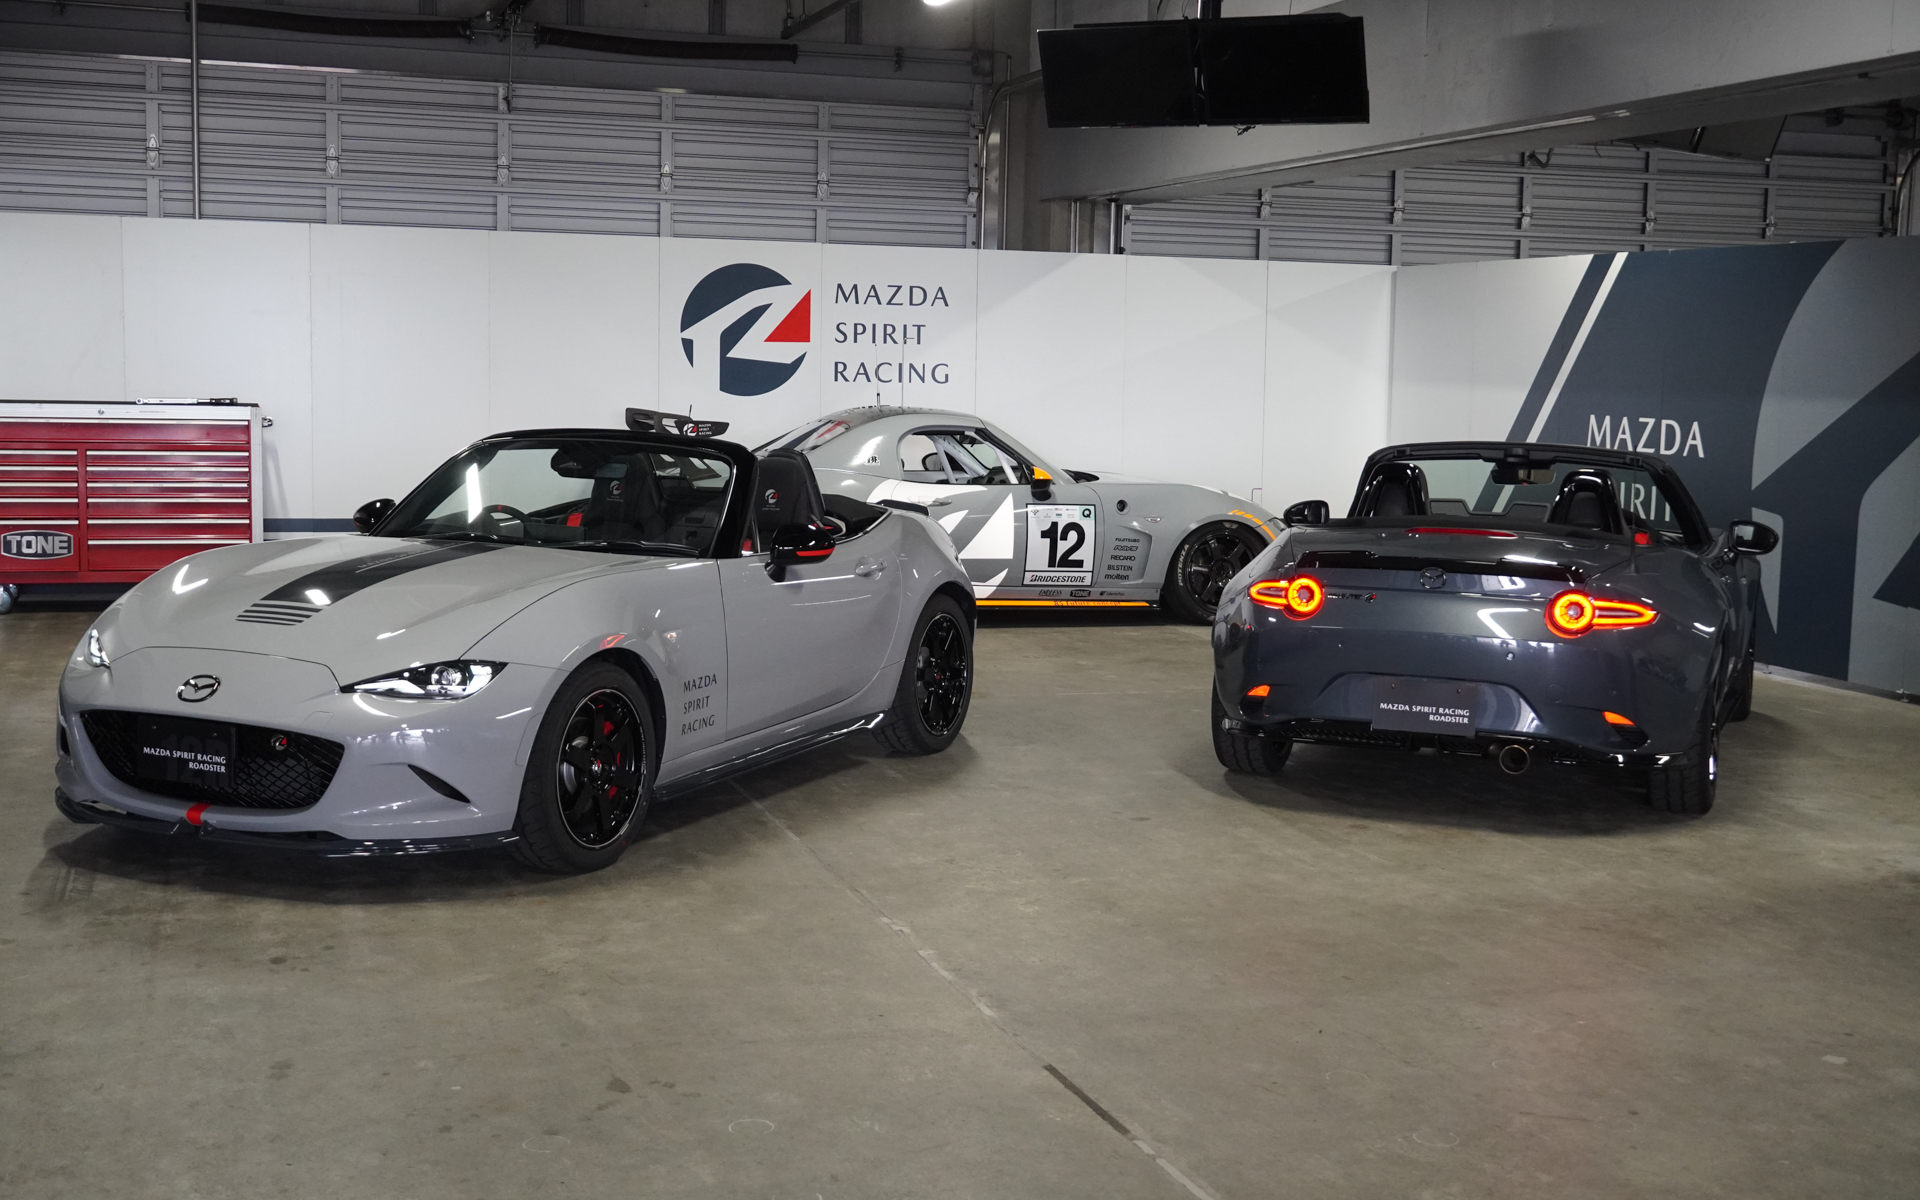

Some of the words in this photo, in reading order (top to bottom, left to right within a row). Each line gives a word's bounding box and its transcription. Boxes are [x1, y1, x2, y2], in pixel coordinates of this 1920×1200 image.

[835, 283, 949, 307] MAZDA
[834, 322, 926, 345] SPIRIT
[834, 361, 949, 385] RACING
[1587, 414, 1705, 458] MAZDA
[1620, 481, 1671, 522] IRI
[1082, 508, 1092, 518] Q
[6, 535, 69, 553] TONE
[1040, 521, 1086, 568] 12
[1177, 544, 1190, 586] POTENZA
[1029, 574, 1087, 583] BRIDGESTONE
[683, 673, 717, 693] MAZDA
[683, 695, 710, 714] SPIRIT
[1379, 702, 1410, 711] MAZDA
[1411, 705, 1437, 713] SPIRIT
[1438, 707, 1470, 716] RACING
[681, 714, 715, 736] RACING
[1428, 714, 1469, 724] ROADSTER
[143, 746, 171, 757] MAZDA
[172, 750, 195, 760] SPIRIT
[197, 753, 226, 764] RACING
[188, 761, 226, 773] ROADSTER
